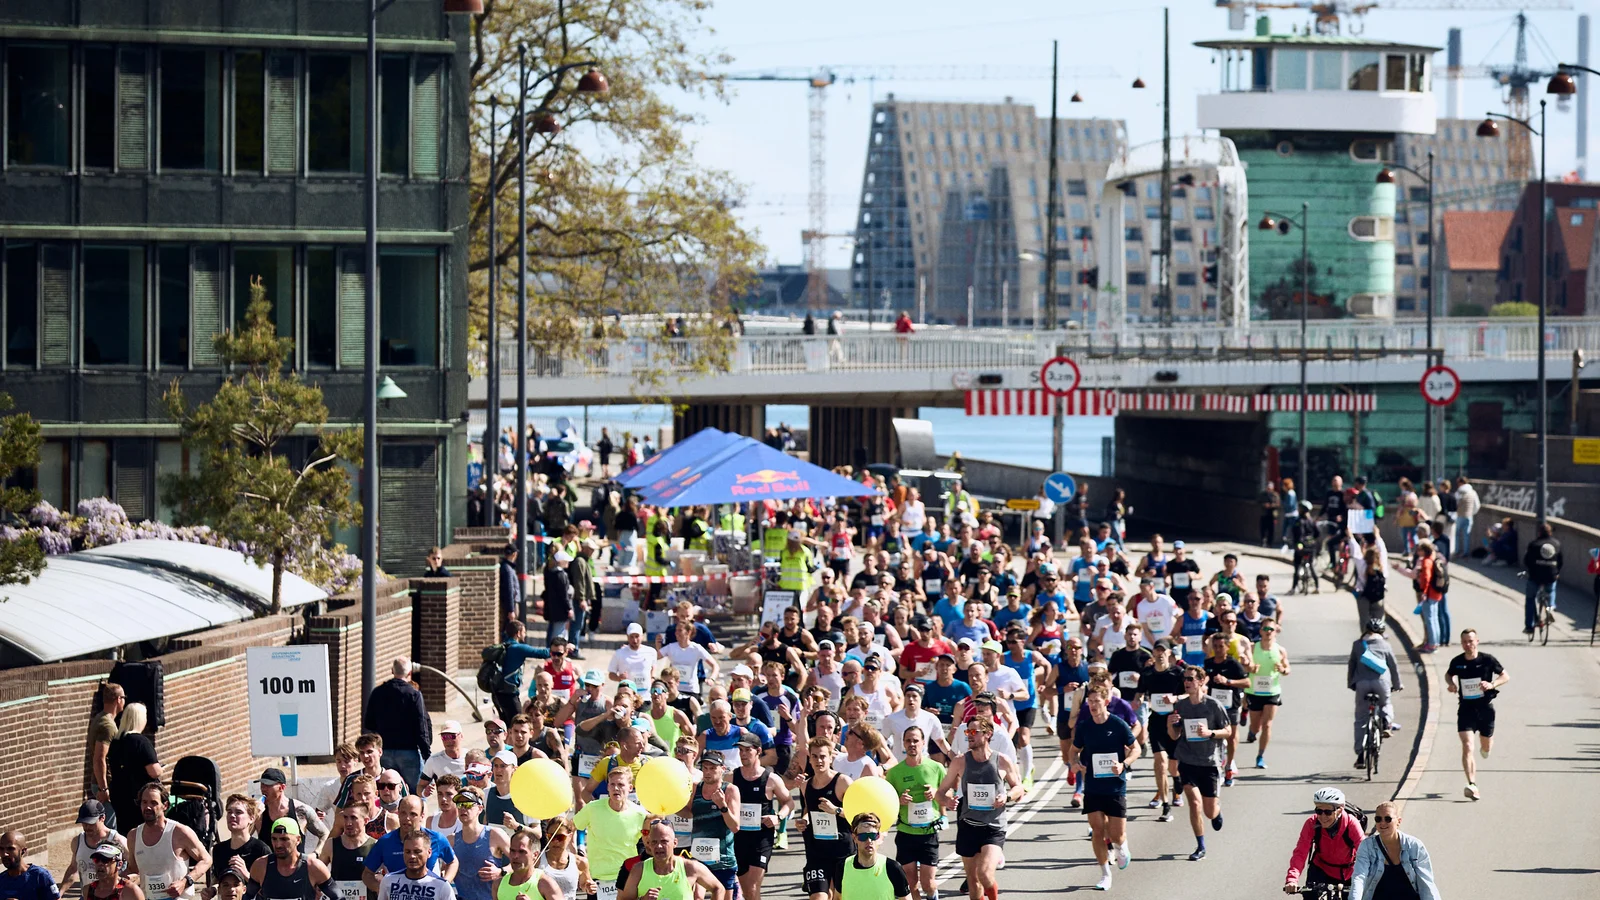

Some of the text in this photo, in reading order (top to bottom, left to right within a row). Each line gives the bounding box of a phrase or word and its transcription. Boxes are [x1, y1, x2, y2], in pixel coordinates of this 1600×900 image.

[731, 481, 810, 496] Red Bull
[259, 677, 316, 694] 100 m
[913, 808, 928, 816] 4102
[815, 819, 831, 827] 9771
[695, 845, 714, 853] 8996
[805, 868, 825, 881] CBS
[148, 882, 166, 891] 3338
[390, 882, 436, 898] PARIS
